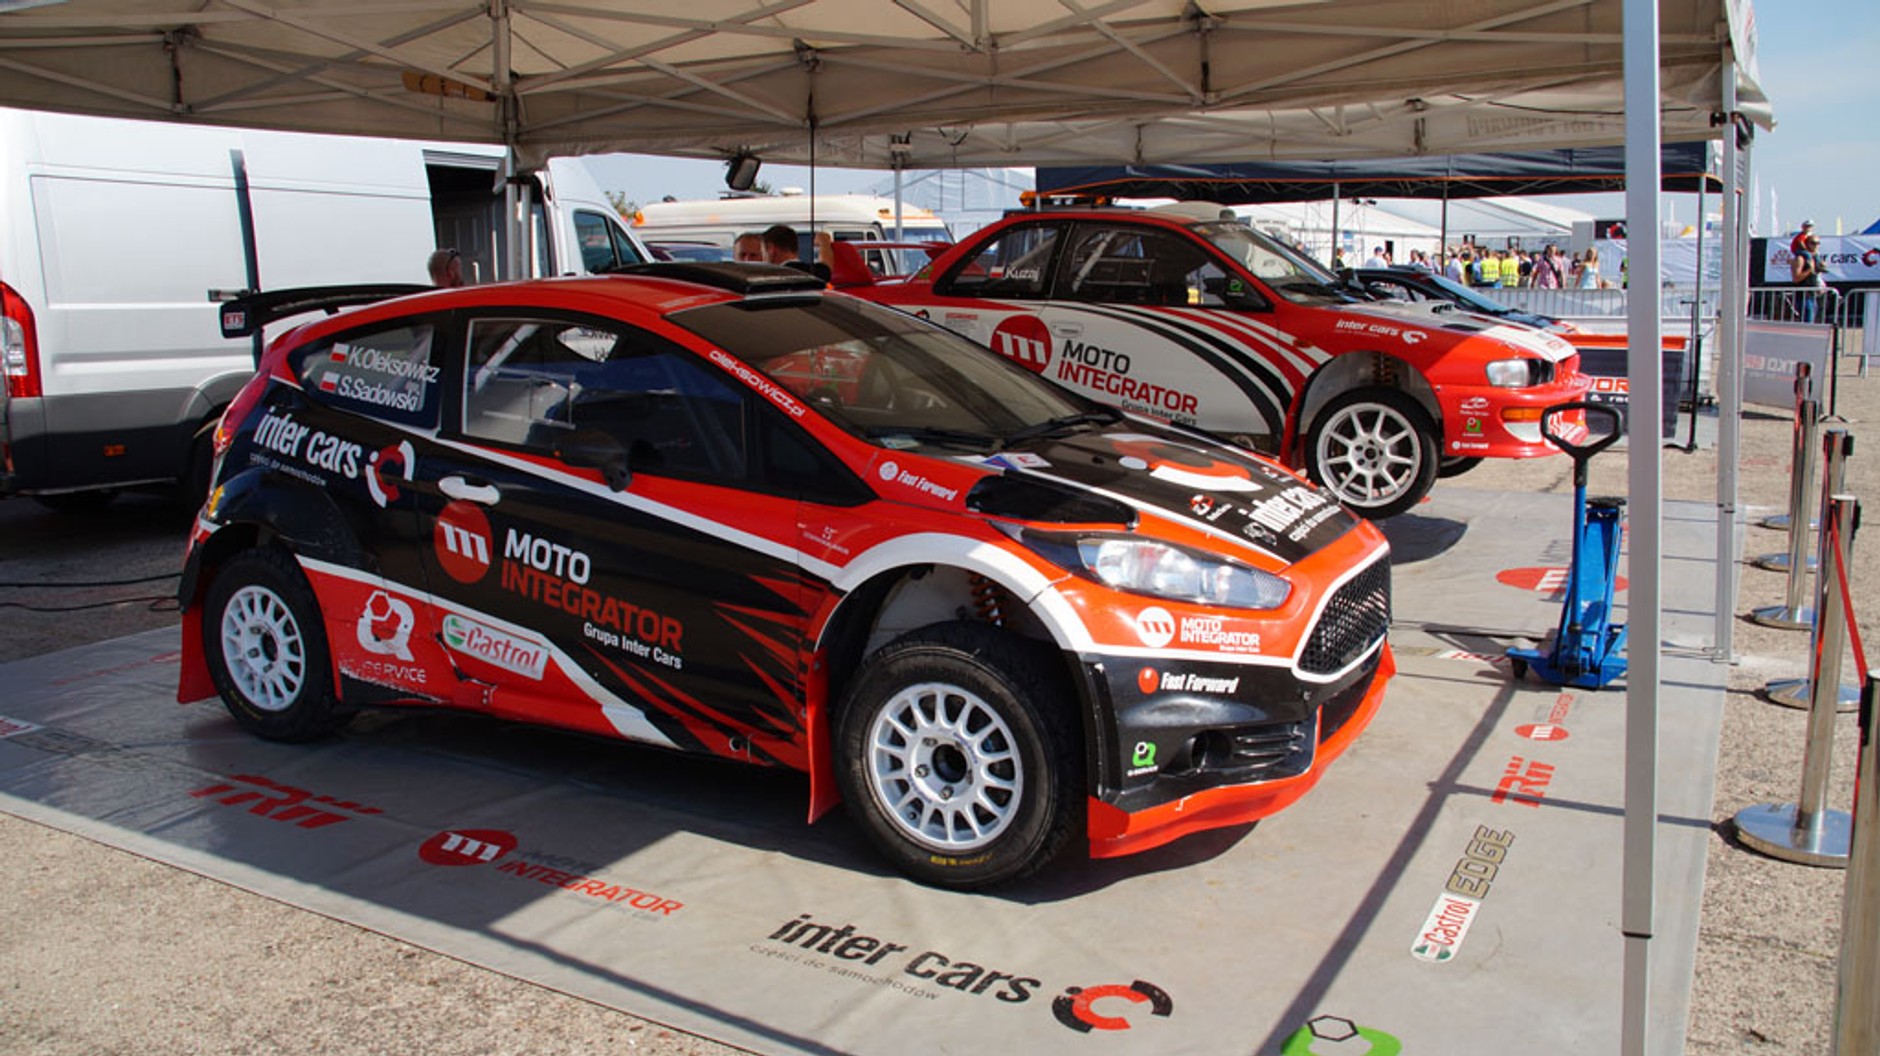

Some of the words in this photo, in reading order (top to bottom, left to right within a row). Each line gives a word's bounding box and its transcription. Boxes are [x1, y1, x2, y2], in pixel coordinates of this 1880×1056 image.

[1336, 318, 1367, 331] inter
[1369, 324, 1399, 336] cars
[349, 345, 440, 384] K.Oleksowicz
[1062, 340, 1130, 375] MOTO
[337, 376, 421, 412] S.Sadowski
[1057, 358, 1198, 415] INTEGRATOR
[253, 407, 307, 457] inter
[306, 430, 362, 479] cars
[898, 470, 919, 487] Fast
[917, 476, 958, 501] Forward
[504, 528, 591, 585] MOTO
[501, 559, 683, 652] INTEGRATOR
[1181, 617, 1222, 632] MOTO
[466, 626, 540, 671] Castrol
[584, 622, 618, 648] Grupa
[621, 635, 652, 657] Inter
[653, 647, 682, 670] Cars
[1180, 629, 1261, 646] INTEGRATOR
[1161, 672, 1186, 691] Fast
[1184, 673, 1239, 693] Forward
[1445, 824, 1515, 899] EDGE
[495, 859, 684, 916] INTEGRATOR
[1424, 898, 1472, 947] Castrol
[768, 914, 907, 965] inter
[903, 950, 1042, 1003] cars
